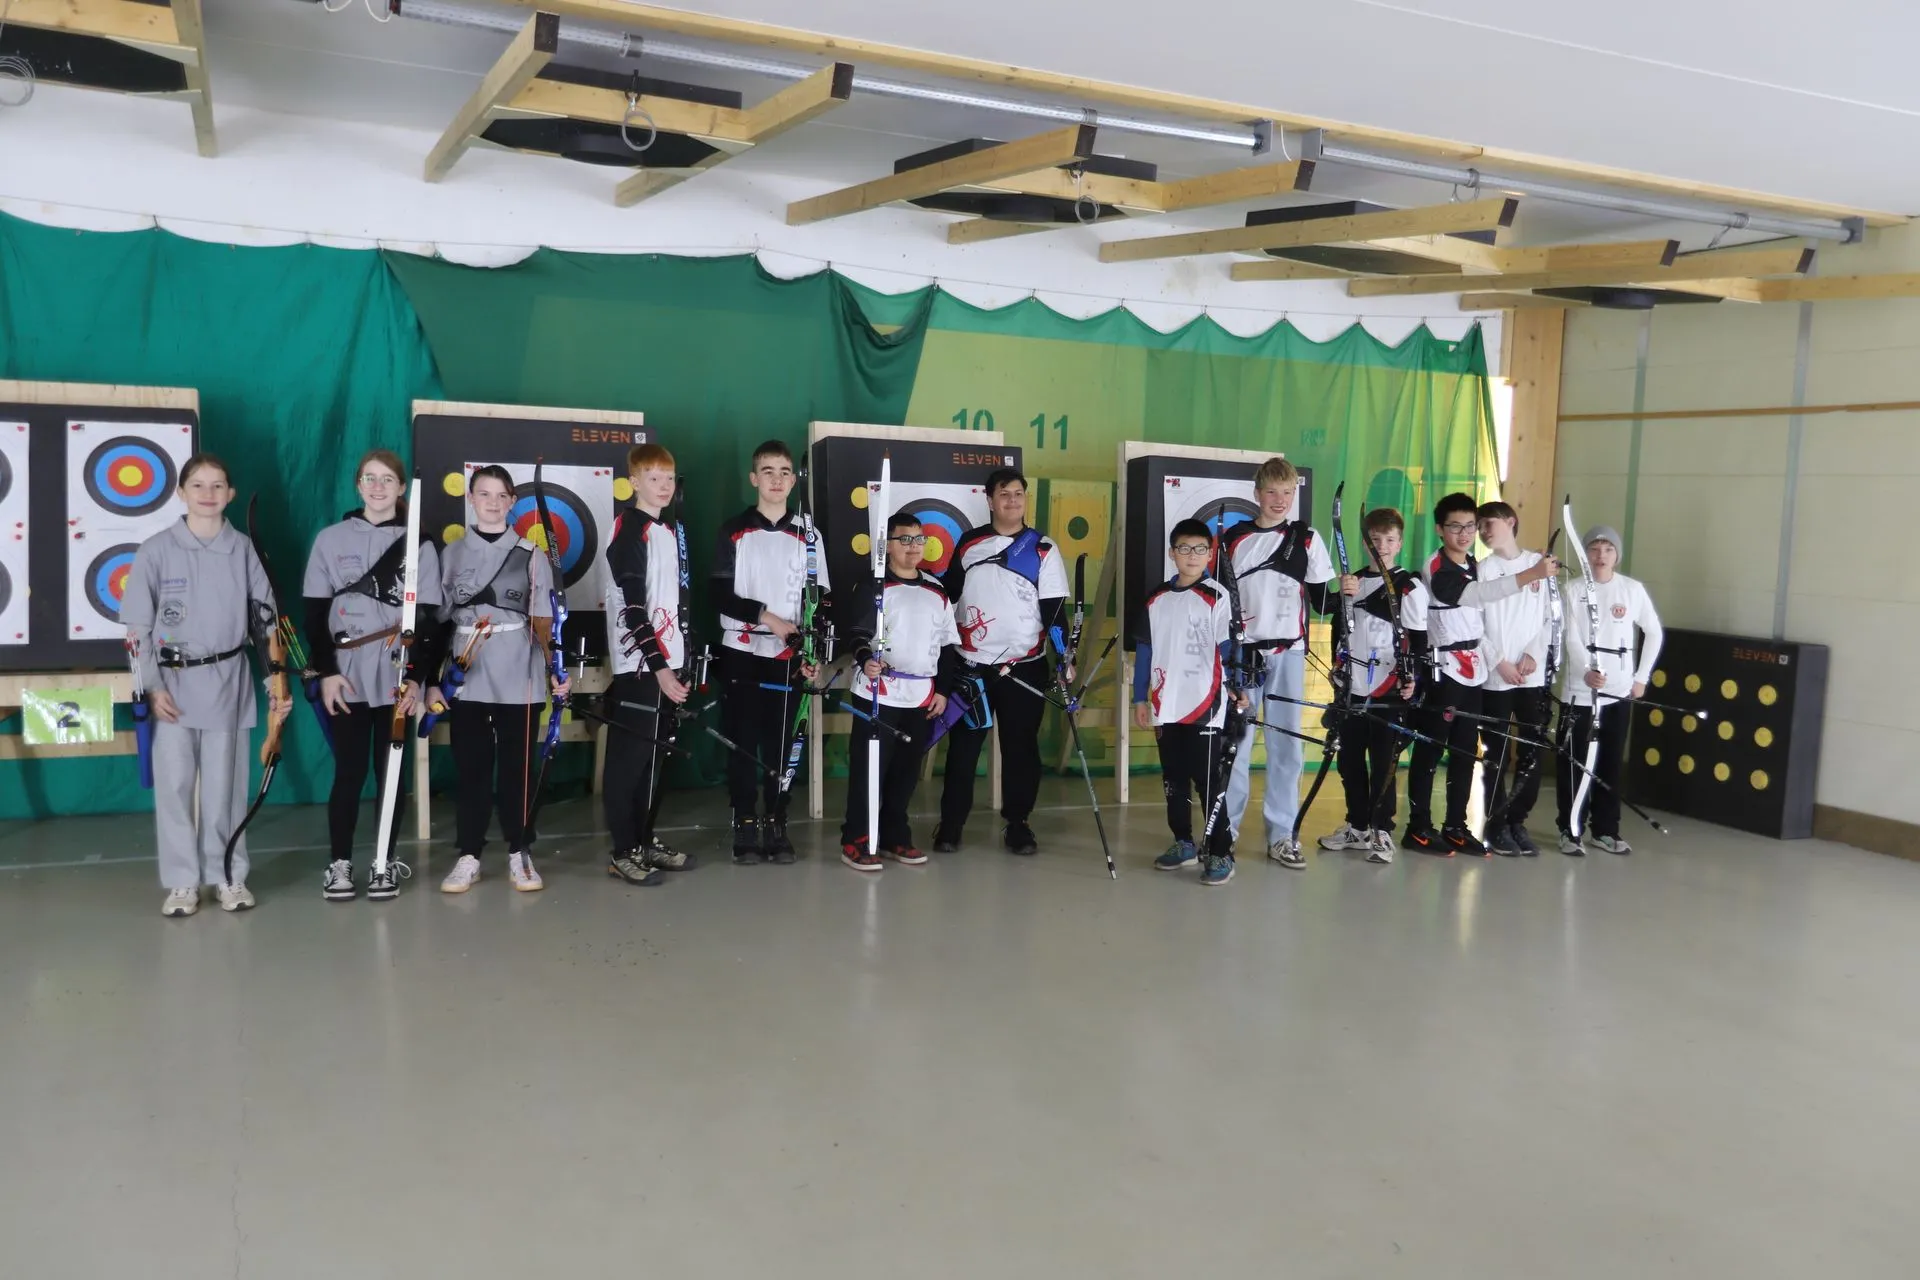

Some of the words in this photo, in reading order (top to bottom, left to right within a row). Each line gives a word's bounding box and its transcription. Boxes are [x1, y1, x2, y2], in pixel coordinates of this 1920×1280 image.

[952, 408, 994, 431] 10
[572, 428, 631, 444] ELEVEN
[1029, 413, 1068, 450] 11
[952, 452, 1001, 466] ELEVEN
[676, 522, 687, 560] CORE
[1185, 614, 1202, 655] BSC
[1732, 647, 1777, 664] ELEVEN
[1184, 664, 1201, 678] 1.
[57, 701, 81, 728] 2
